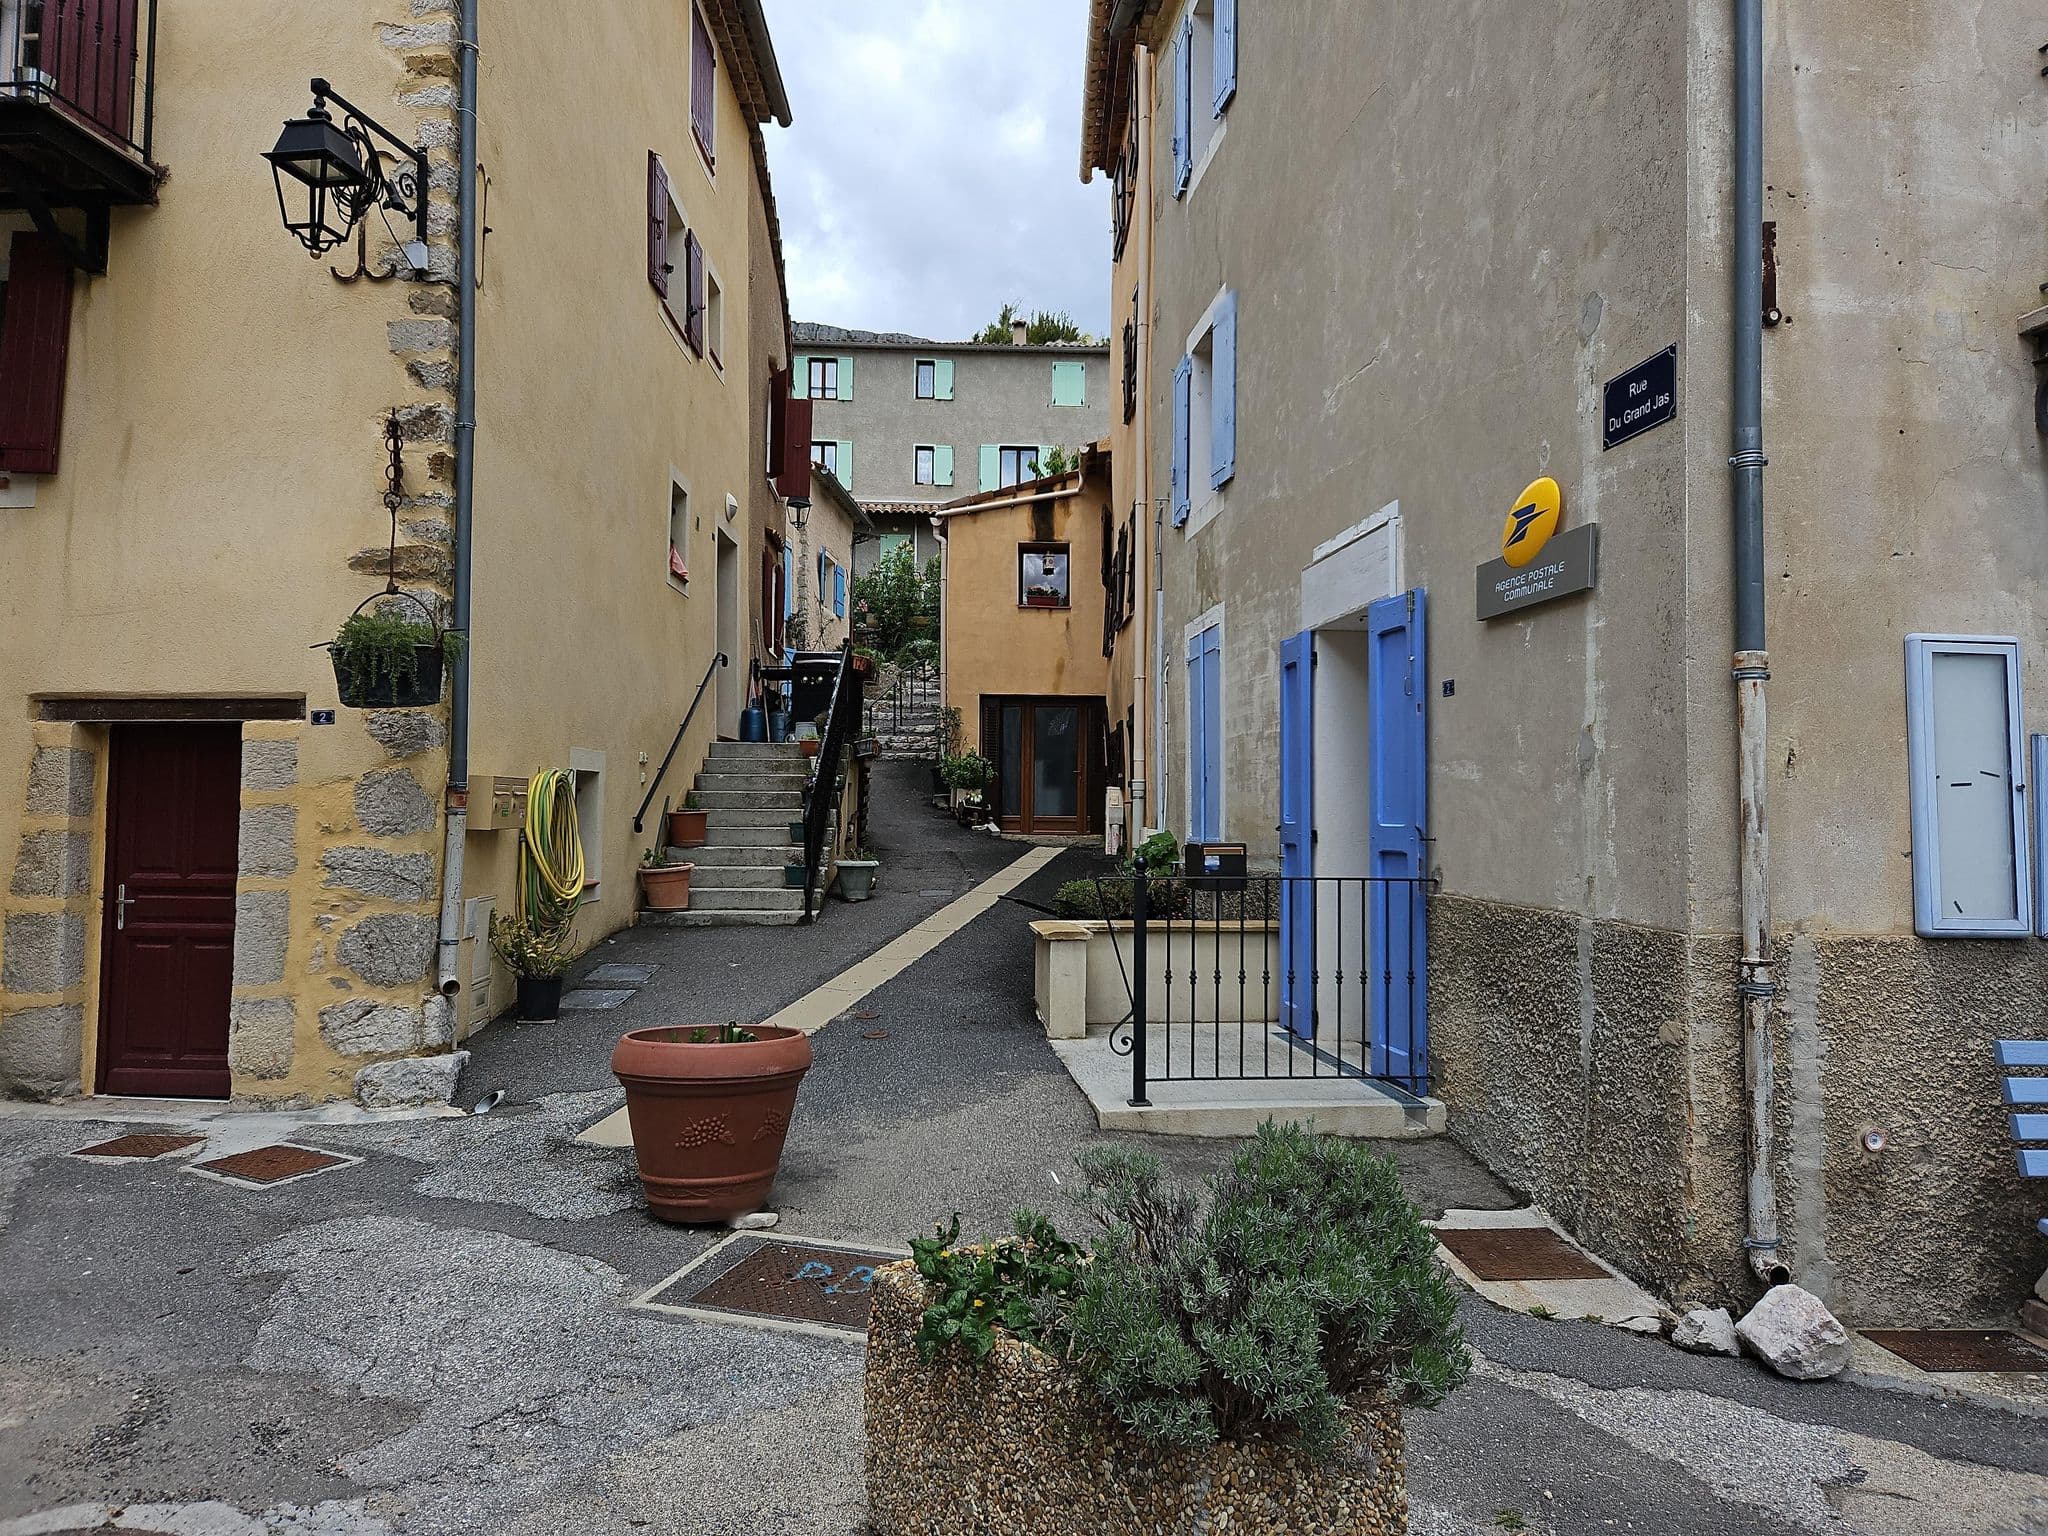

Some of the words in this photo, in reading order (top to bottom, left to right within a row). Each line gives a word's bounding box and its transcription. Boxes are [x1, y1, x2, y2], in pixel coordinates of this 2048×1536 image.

[1629, 379, 1648, 398] Rue
[1609, 417, 1622, 432] Du
[1623, 398, 1651, 424] Grand
[1653, 392, 1670, 410] Jas
[1495, 573, 1526, 593] AGENCE
[1528, 560, 1565, 582] POSTALE
[1503, 577, 1555, 602] COMMUNALE
[319, 712, 327, 722] 2
